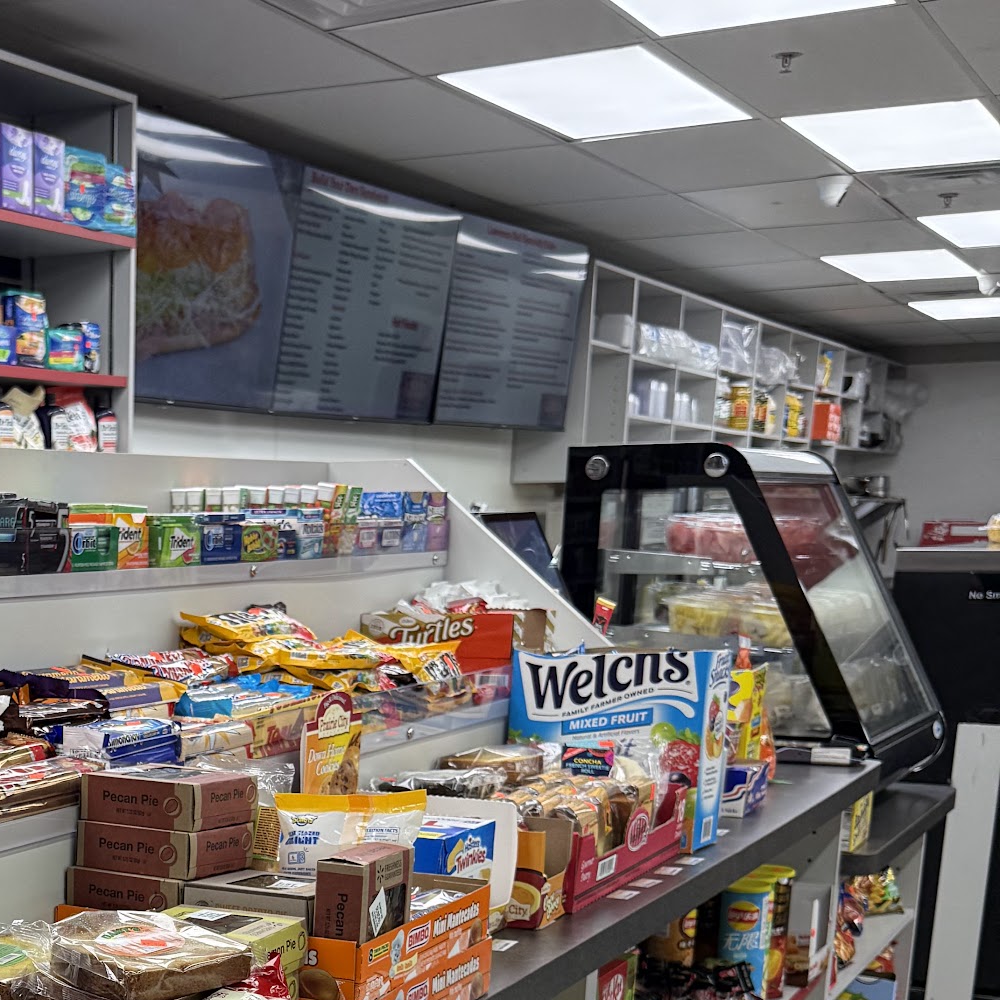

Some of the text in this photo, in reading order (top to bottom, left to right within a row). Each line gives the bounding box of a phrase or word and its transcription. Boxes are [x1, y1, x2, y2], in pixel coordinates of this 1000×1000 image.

[170, 535, 194, 550] Trident
[968, 591, 984, 600] No
[391, 615, 475, 645] Turtles
[562, 688, 655, 718] FAMILY FARMER OWNED
[569, 711, 648, 730] MIXED FRUIT
[103, 790, 159, 807] Pecan Pie
[210, 788, 244, 803] Pecan Pie
[99, 838, 155, 854] Pecan Pie
[206, 837, 240, 852] Pecan Pie
[456, 848, 487, 873] Twinkies
[88, 884, 145, 902] Pecan Pie
[335, 892, 348, 937] Pecan
[508, 904, 528, 916] City
[407, 926, 429, 948] BIMBO
[433, 918, 448, 939] Mini
[286, 940, 296, 951] Pie
[432, 974, 447, 995] Mini
